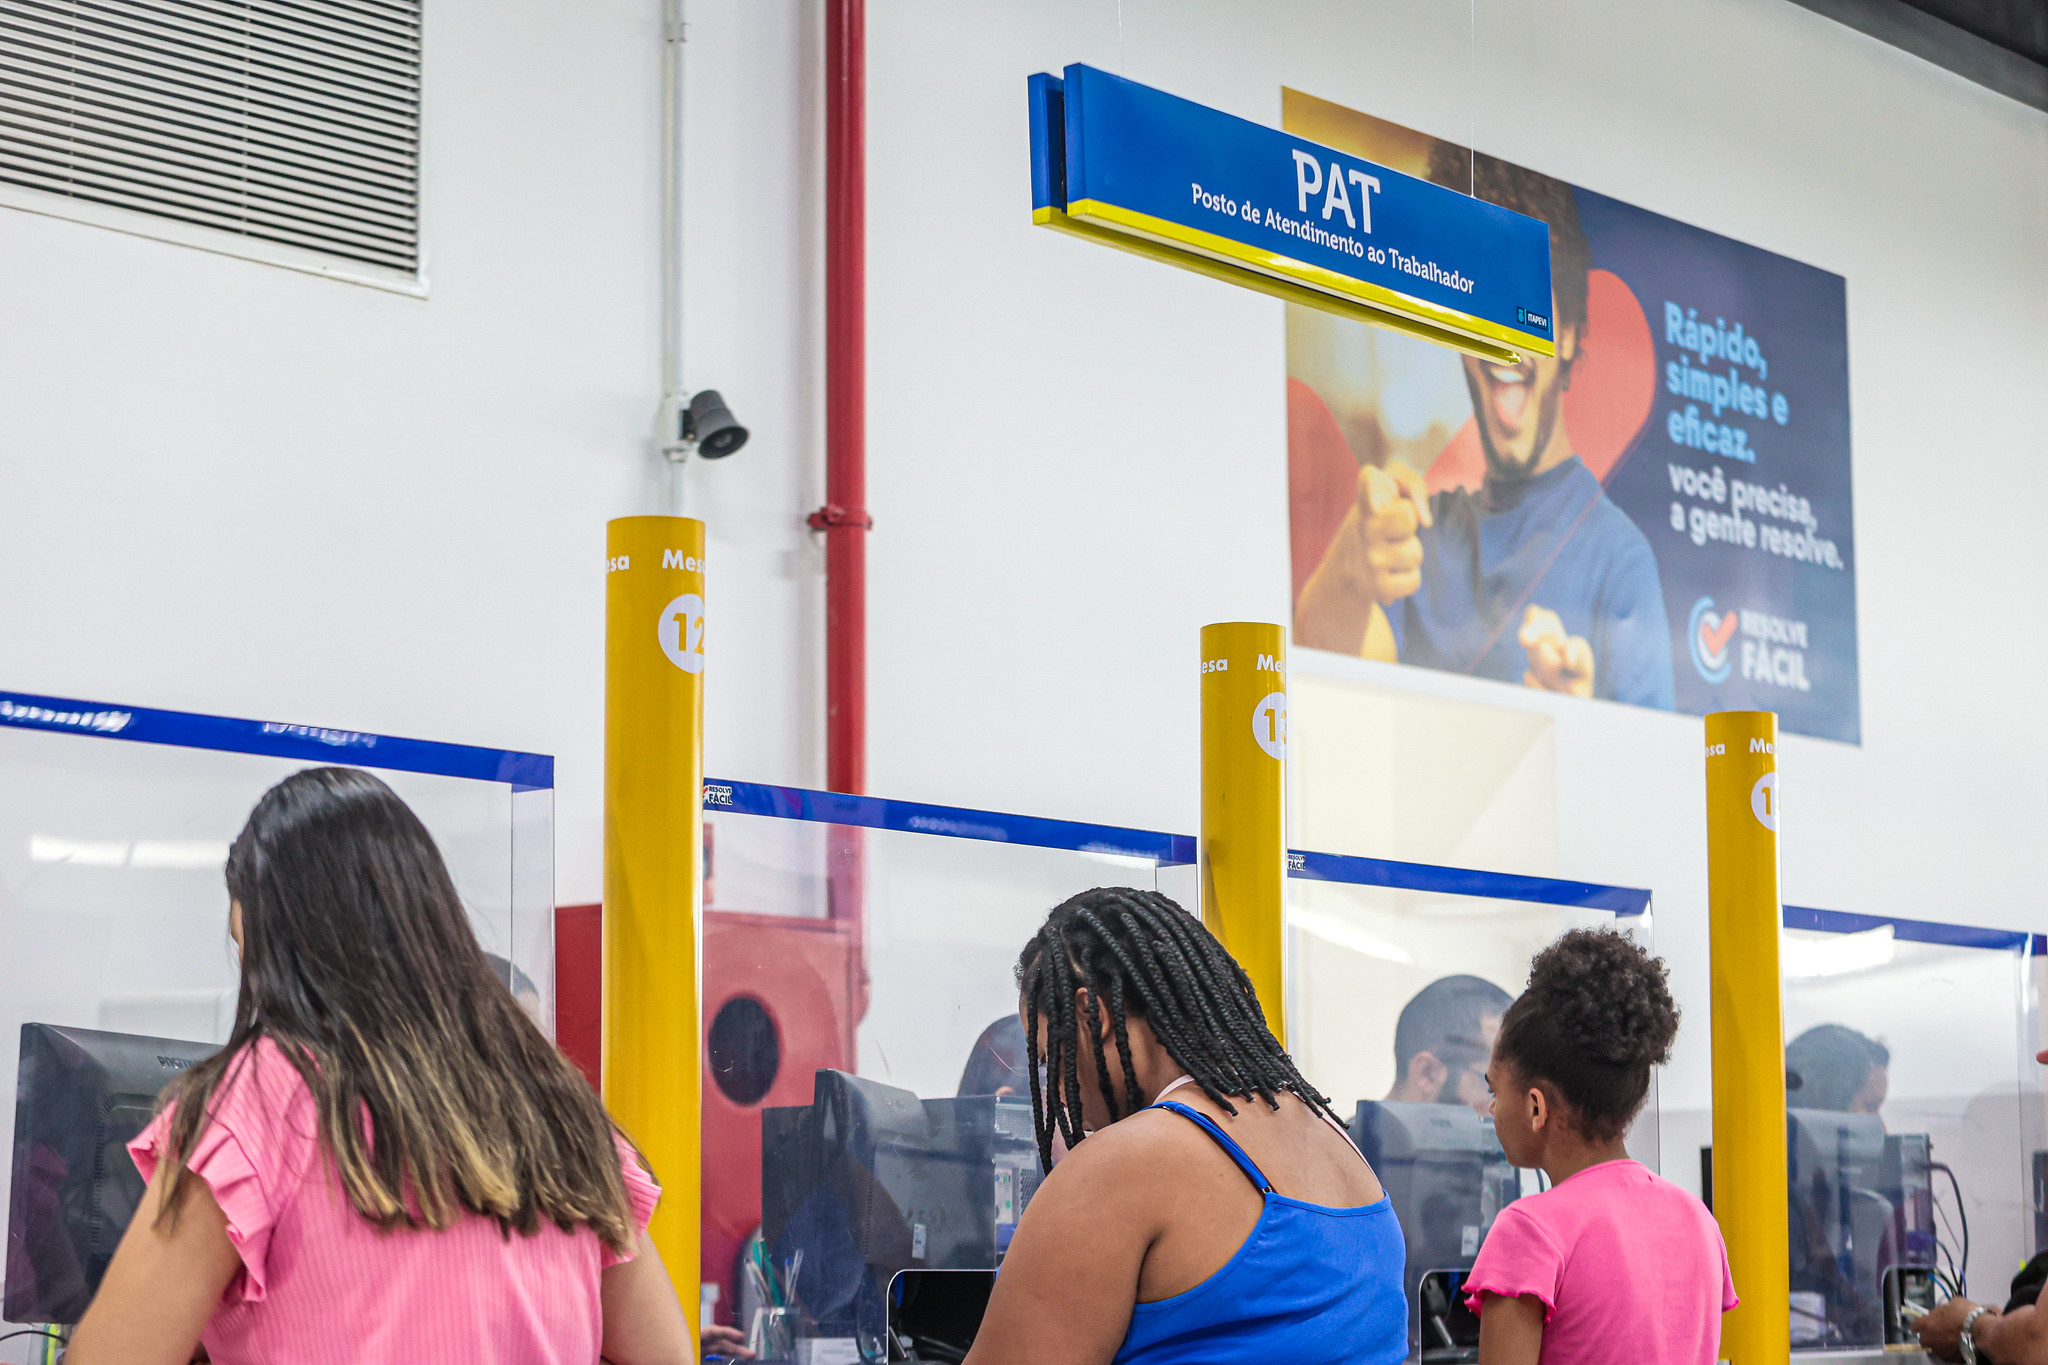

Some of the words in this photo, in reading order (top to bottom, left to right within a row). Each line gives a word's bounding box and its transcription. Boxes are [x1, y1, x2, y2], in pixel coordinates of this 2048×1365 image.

[1292, 148, 1380, 234] PAT
[1191, 183, 1237, 216] Posto
[1241, 200, 1261, 224] de
[1264, 208, 1364, 258] Atendimento
[1367, 245, 1386, 265] ao
[1388, 247, 1474, 294] Trabalhador
[1527, 313, 1548, 327] ITAPEVI
[1664, 300, 1768, 380] Rápido,
[1666, 353, 1769, 420] simples
[1771, 392, 1790, 426] e
[1667, 403, 1757, 464] eficaz.
[1667, 464, 1727, 504] você
[1731, 478, 1818, 534] precisa,
[1669, 501, 1686, 532] a
[1689, 506, 1757, 549] gente
[1759, 522, 1844, 570] resolve.
[605, 555, 630, 574] esa
[673, 612, 705, 656] 12
[1200, 658, 1228, 674] esa
[1256, 653, 1286, 674] Me
[709, 786, 732, 794] RESOLVE
[1761, 786, 1772, 816] 1
[157, 1055, 194, 1070] POSITI
